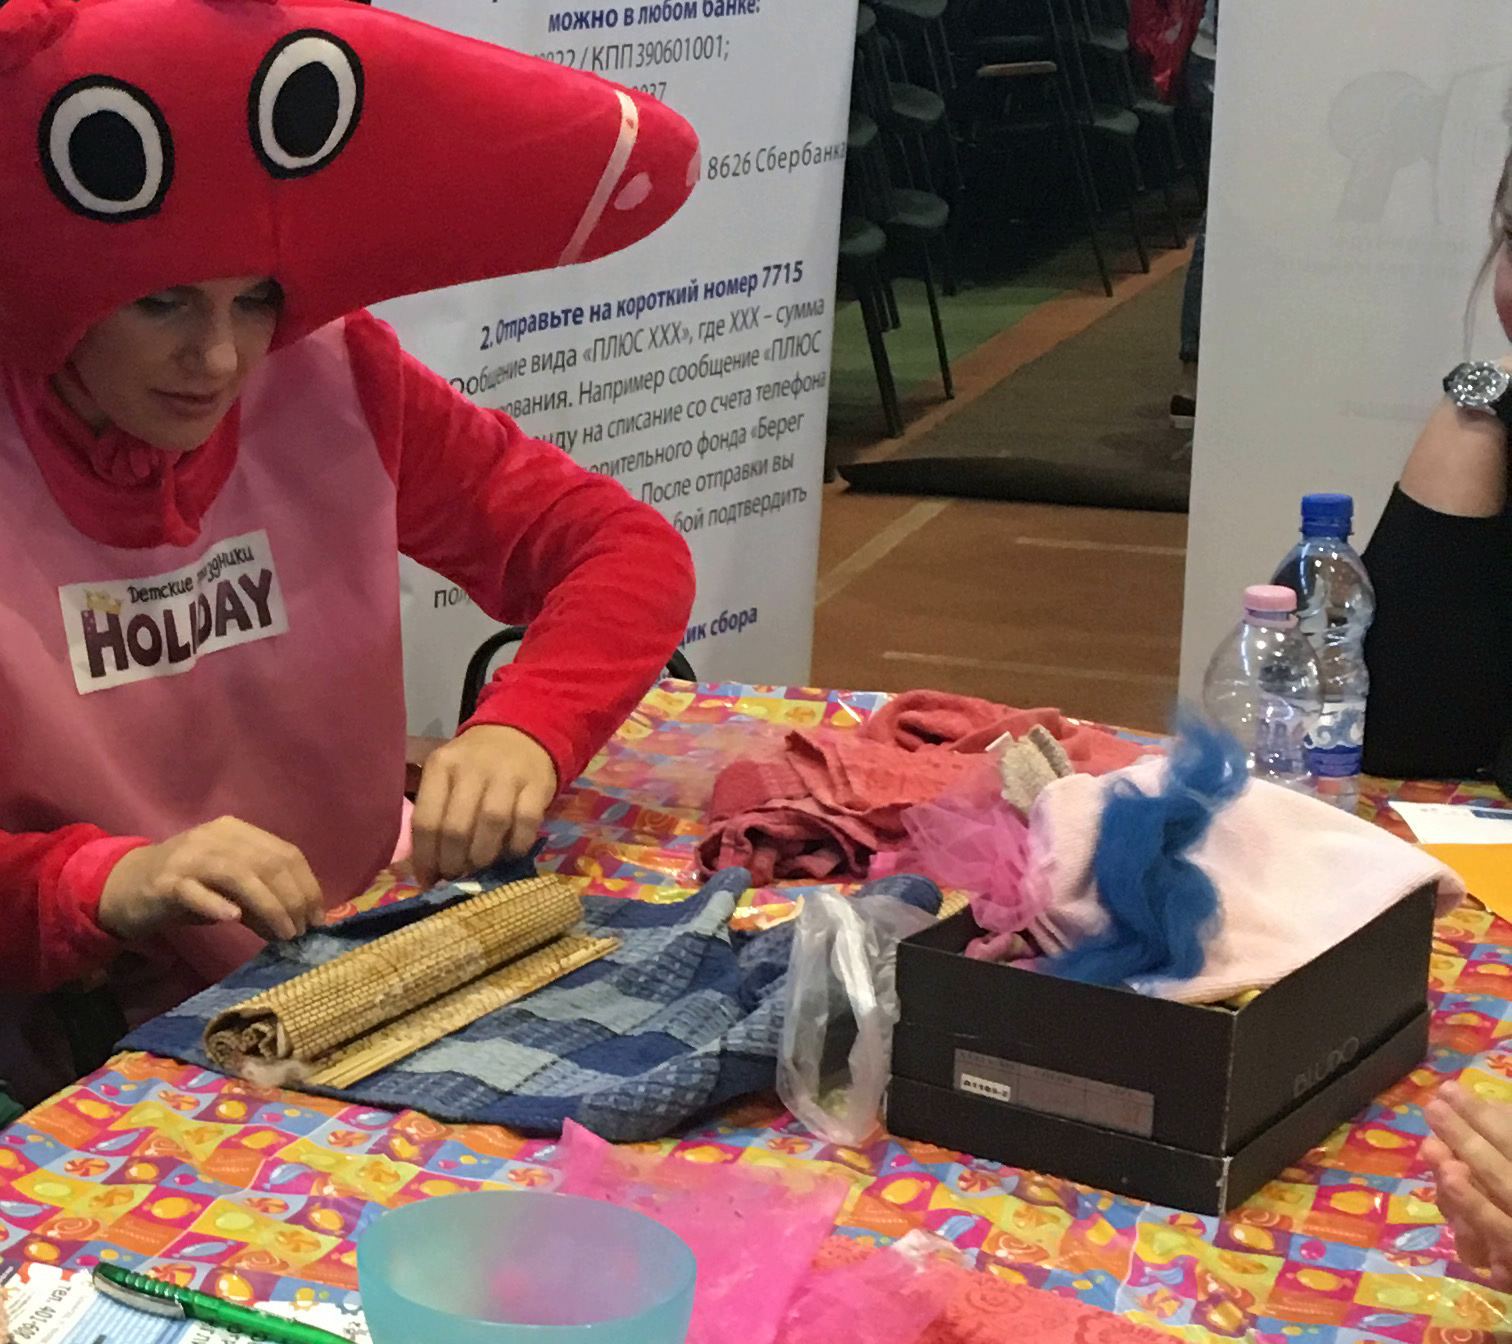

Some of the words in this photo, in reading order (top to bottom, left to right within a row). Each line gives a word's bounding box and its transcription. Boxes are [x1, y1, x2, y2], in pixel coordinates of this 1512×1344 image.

[548, 8, 618, 33] можно
[623, 7, 636, 27] в
[591, 43, 634, 72] КПП
[636, 34, 730, 67] 390601001;
[706, 152, 752, 180] 8626
[495, 305, 585, 345] Отправьте
[589, 301, 612, 323] на
[615, 277, 699, 320] короткий
[703, 270, 758, 301] номер
[761, 260, 804, 289] 7715
[531, 344, 578, 375] вида
[582, 327, 645, 364] «ПЛЮС
[697, 316, 726, 342] где
[775, 295, 825, 327] сумма
[578, 367, 665, 406] Например
[668, 347, 760, 385] сообщение
[763, 329, 822, 362] «ПЛЮС
[582, 422, 603, 445] на
[607, 401, 683, 439] списание
[686, 397, 707, 419] со
[710, 385, 752, 414] счета
[755, 369, 828, 403] телефона
[696, 425, 747, 460] фонда
[641, 476, 691, 505] После
[694, 456, 768, 492] отправки
[772, 452, 795, 472] вы
[707, 485, 807, 527] подтвердить
[127, 576, 194, 604] Детские
[709, 606, 758, 637] сбора
